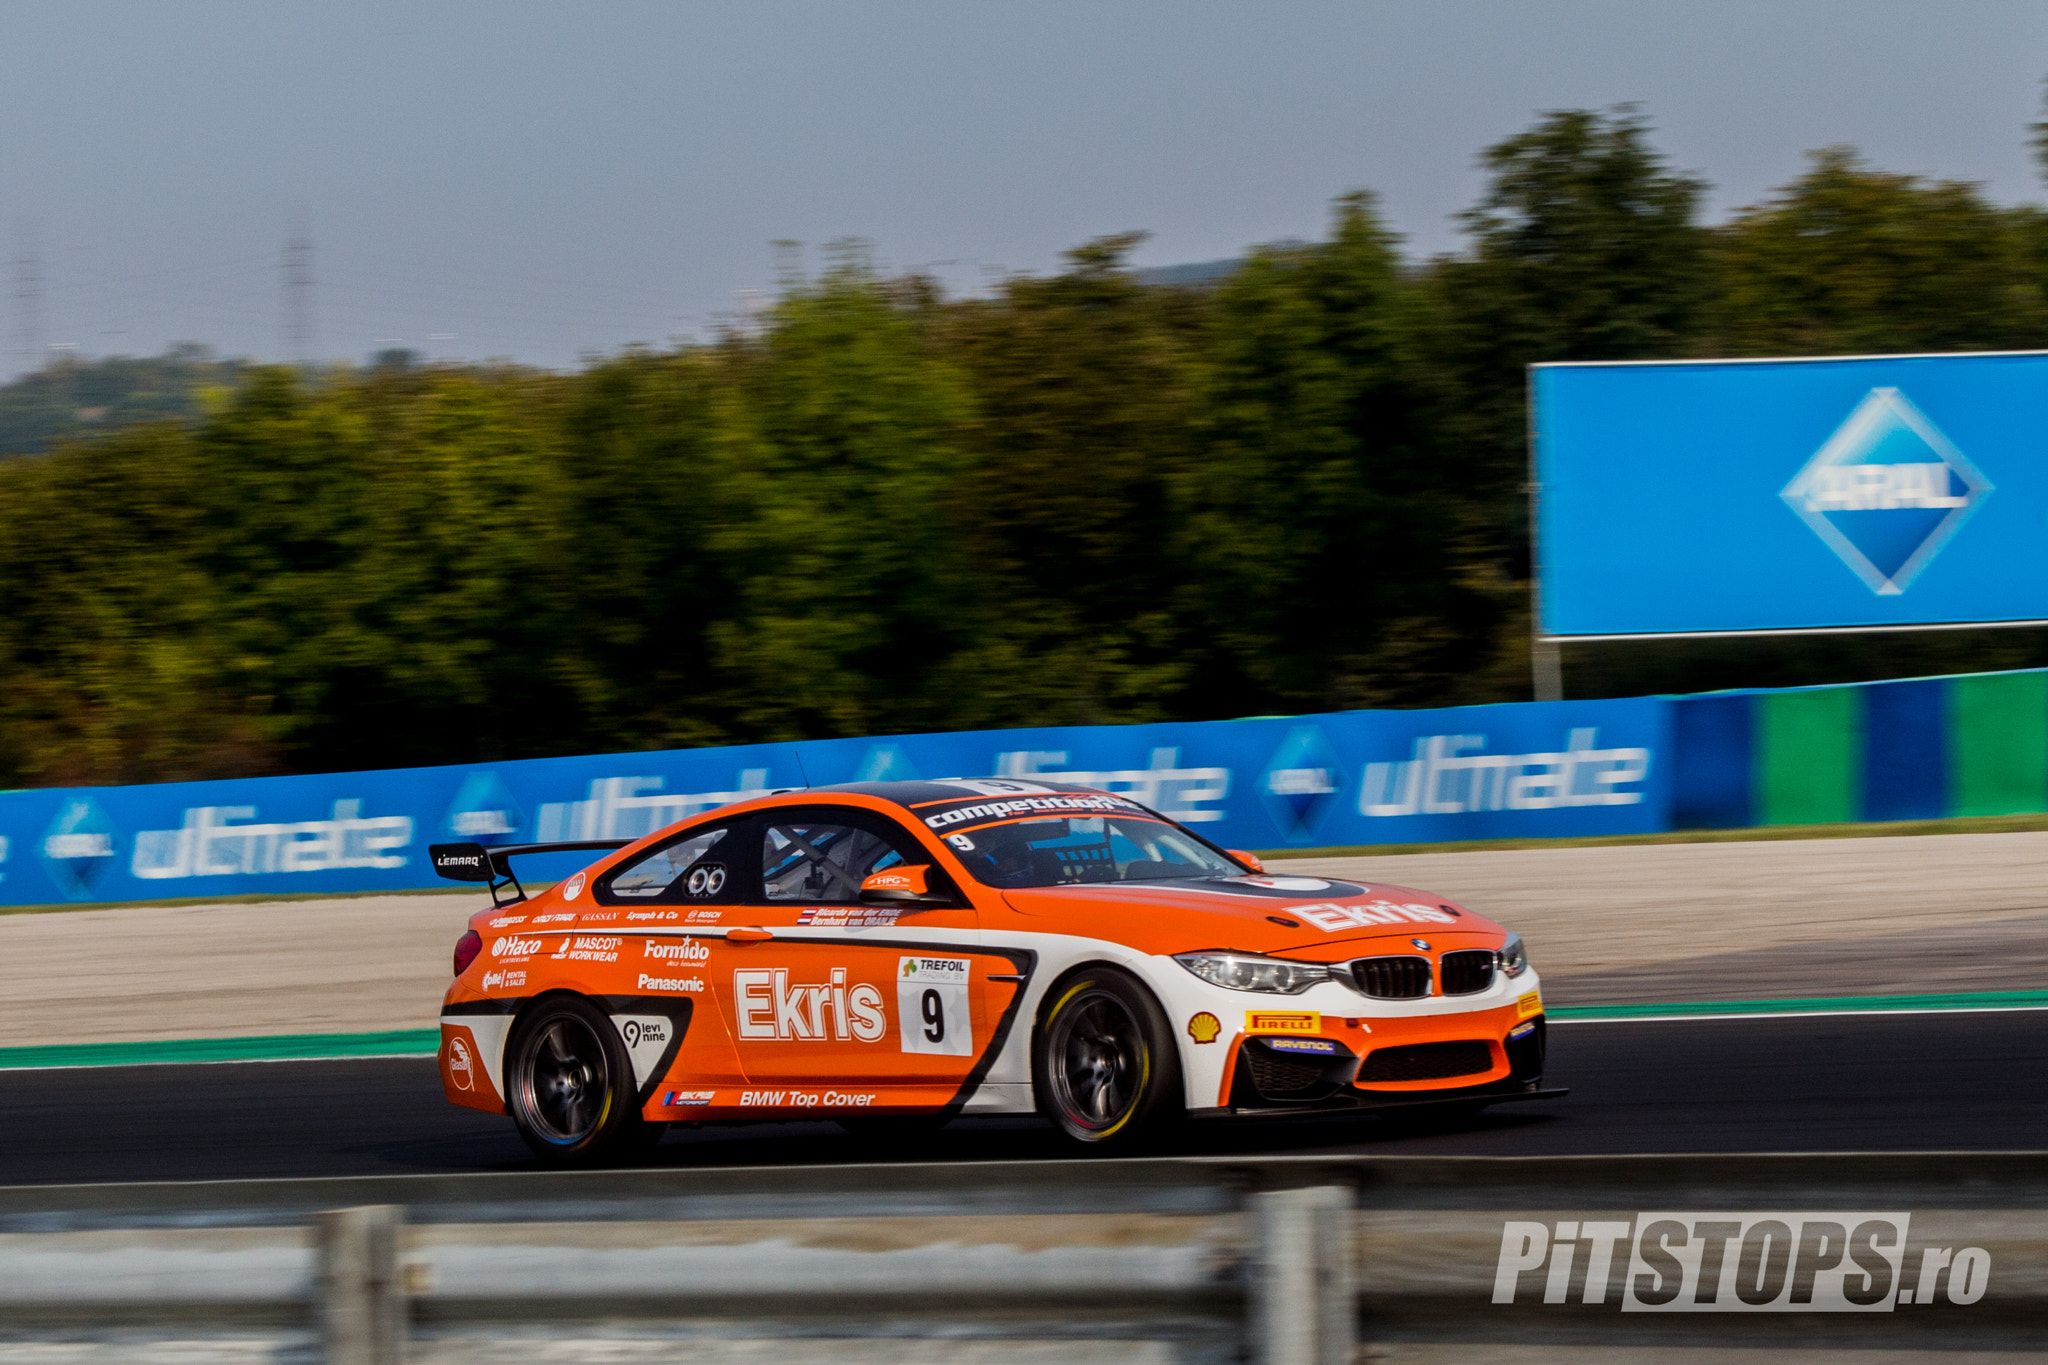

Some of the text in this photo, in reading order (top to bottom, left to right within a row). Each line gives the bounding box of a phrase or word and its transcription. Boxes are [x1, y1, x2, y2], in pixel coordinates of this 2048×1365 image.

[948, 835, 975, 852] 9
[438, 855, 479, 867] LEMARQ
[697, 911, 722, 919] BOSCH
[1283, 899, 1457, 933] Ekris
[503, 936, 542, 955] Haco
[644, 938, 710, 960] Formido
[568, 951, 618, 963] WORKWEAR
[920, 959, 965, 972] TREFOIL
[506, 971, 527, 979] RENTAL
[509, 978, 526, 987] SALES
[638, 973, 704, 992] Panasonic
[734, 967, 886, 1042] Ekris
[921, 988, 945, 1043] 9
[1253, 1014, 1312, 1030] PIRELLI
[642, 1022, 660, 1033] levi
[642, 1031, 666, 1042] nine
[1272, 1039, 1334, 1051] RAVENOL
[740, 1090, 876, 1108] BMW Top Cover
